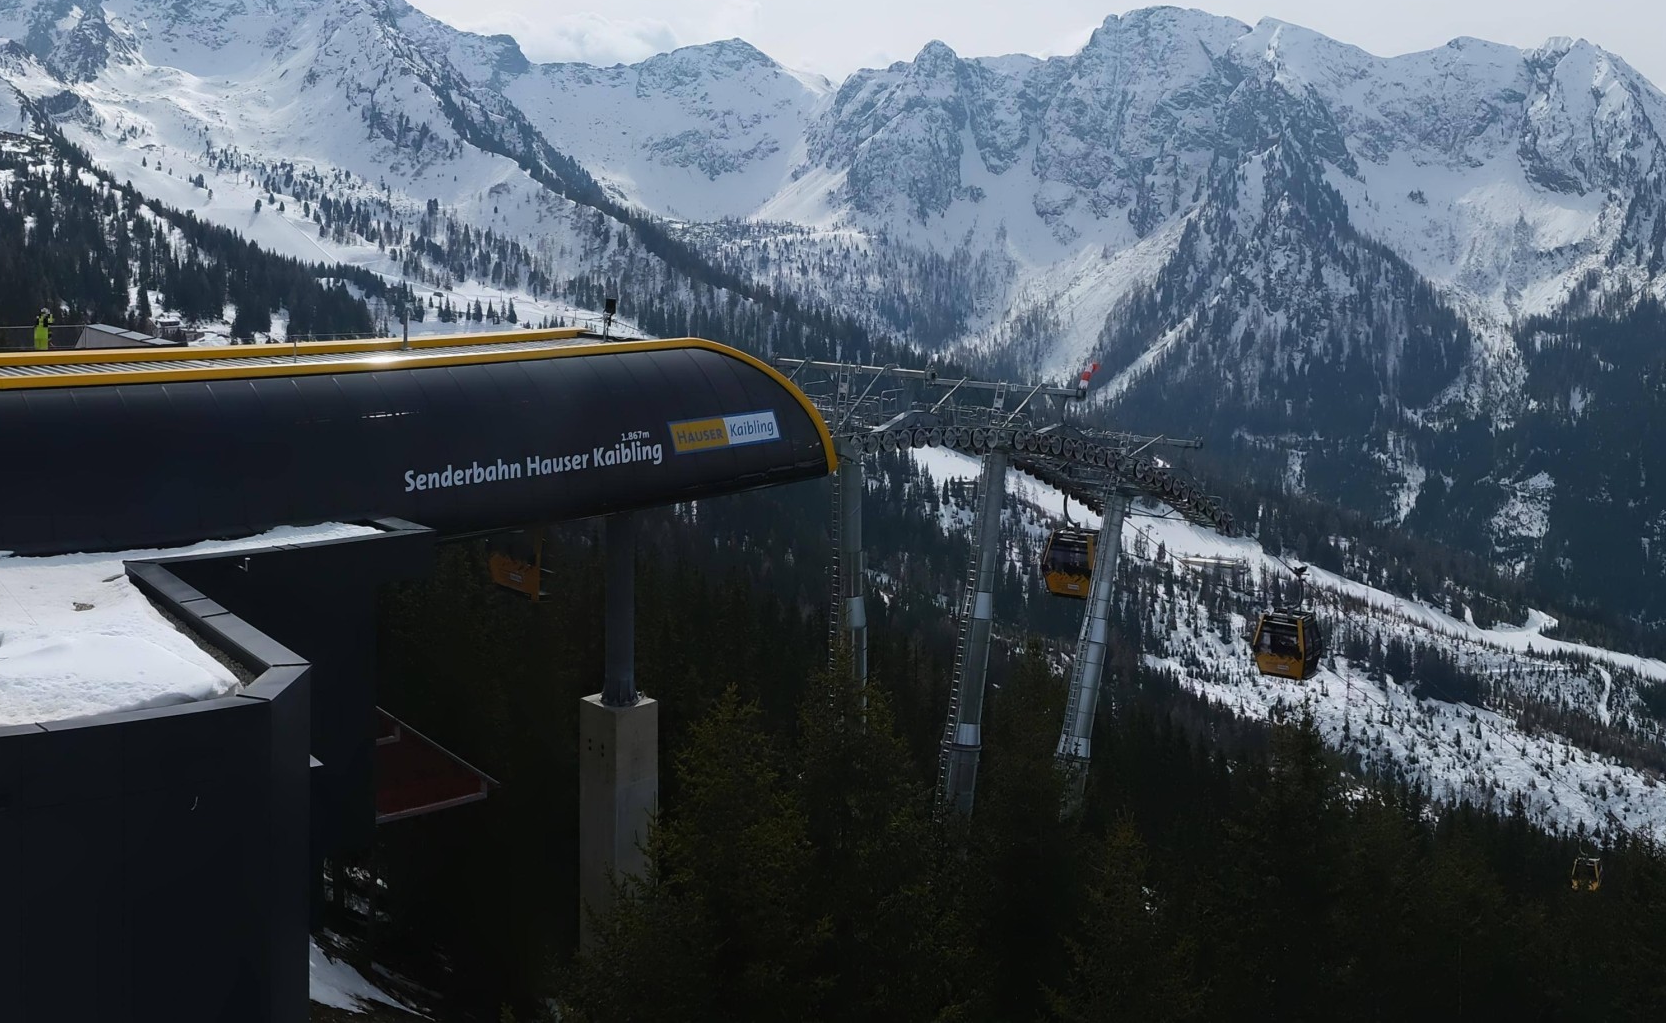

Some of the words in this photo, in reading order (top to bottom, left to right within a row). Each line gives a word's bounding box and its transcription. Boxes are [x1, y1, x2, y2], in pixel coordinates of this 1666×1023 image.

[621, 430, 650, 442] 1.867m
[676, 428, 724, 444] HAUSER
[730, 420, 774, 437] Kaibling
[404, 459, 521, 492] Senderbahn
[526, 452, 589, 477] Hauser
[593, 441, 662, 467] Kaibling
